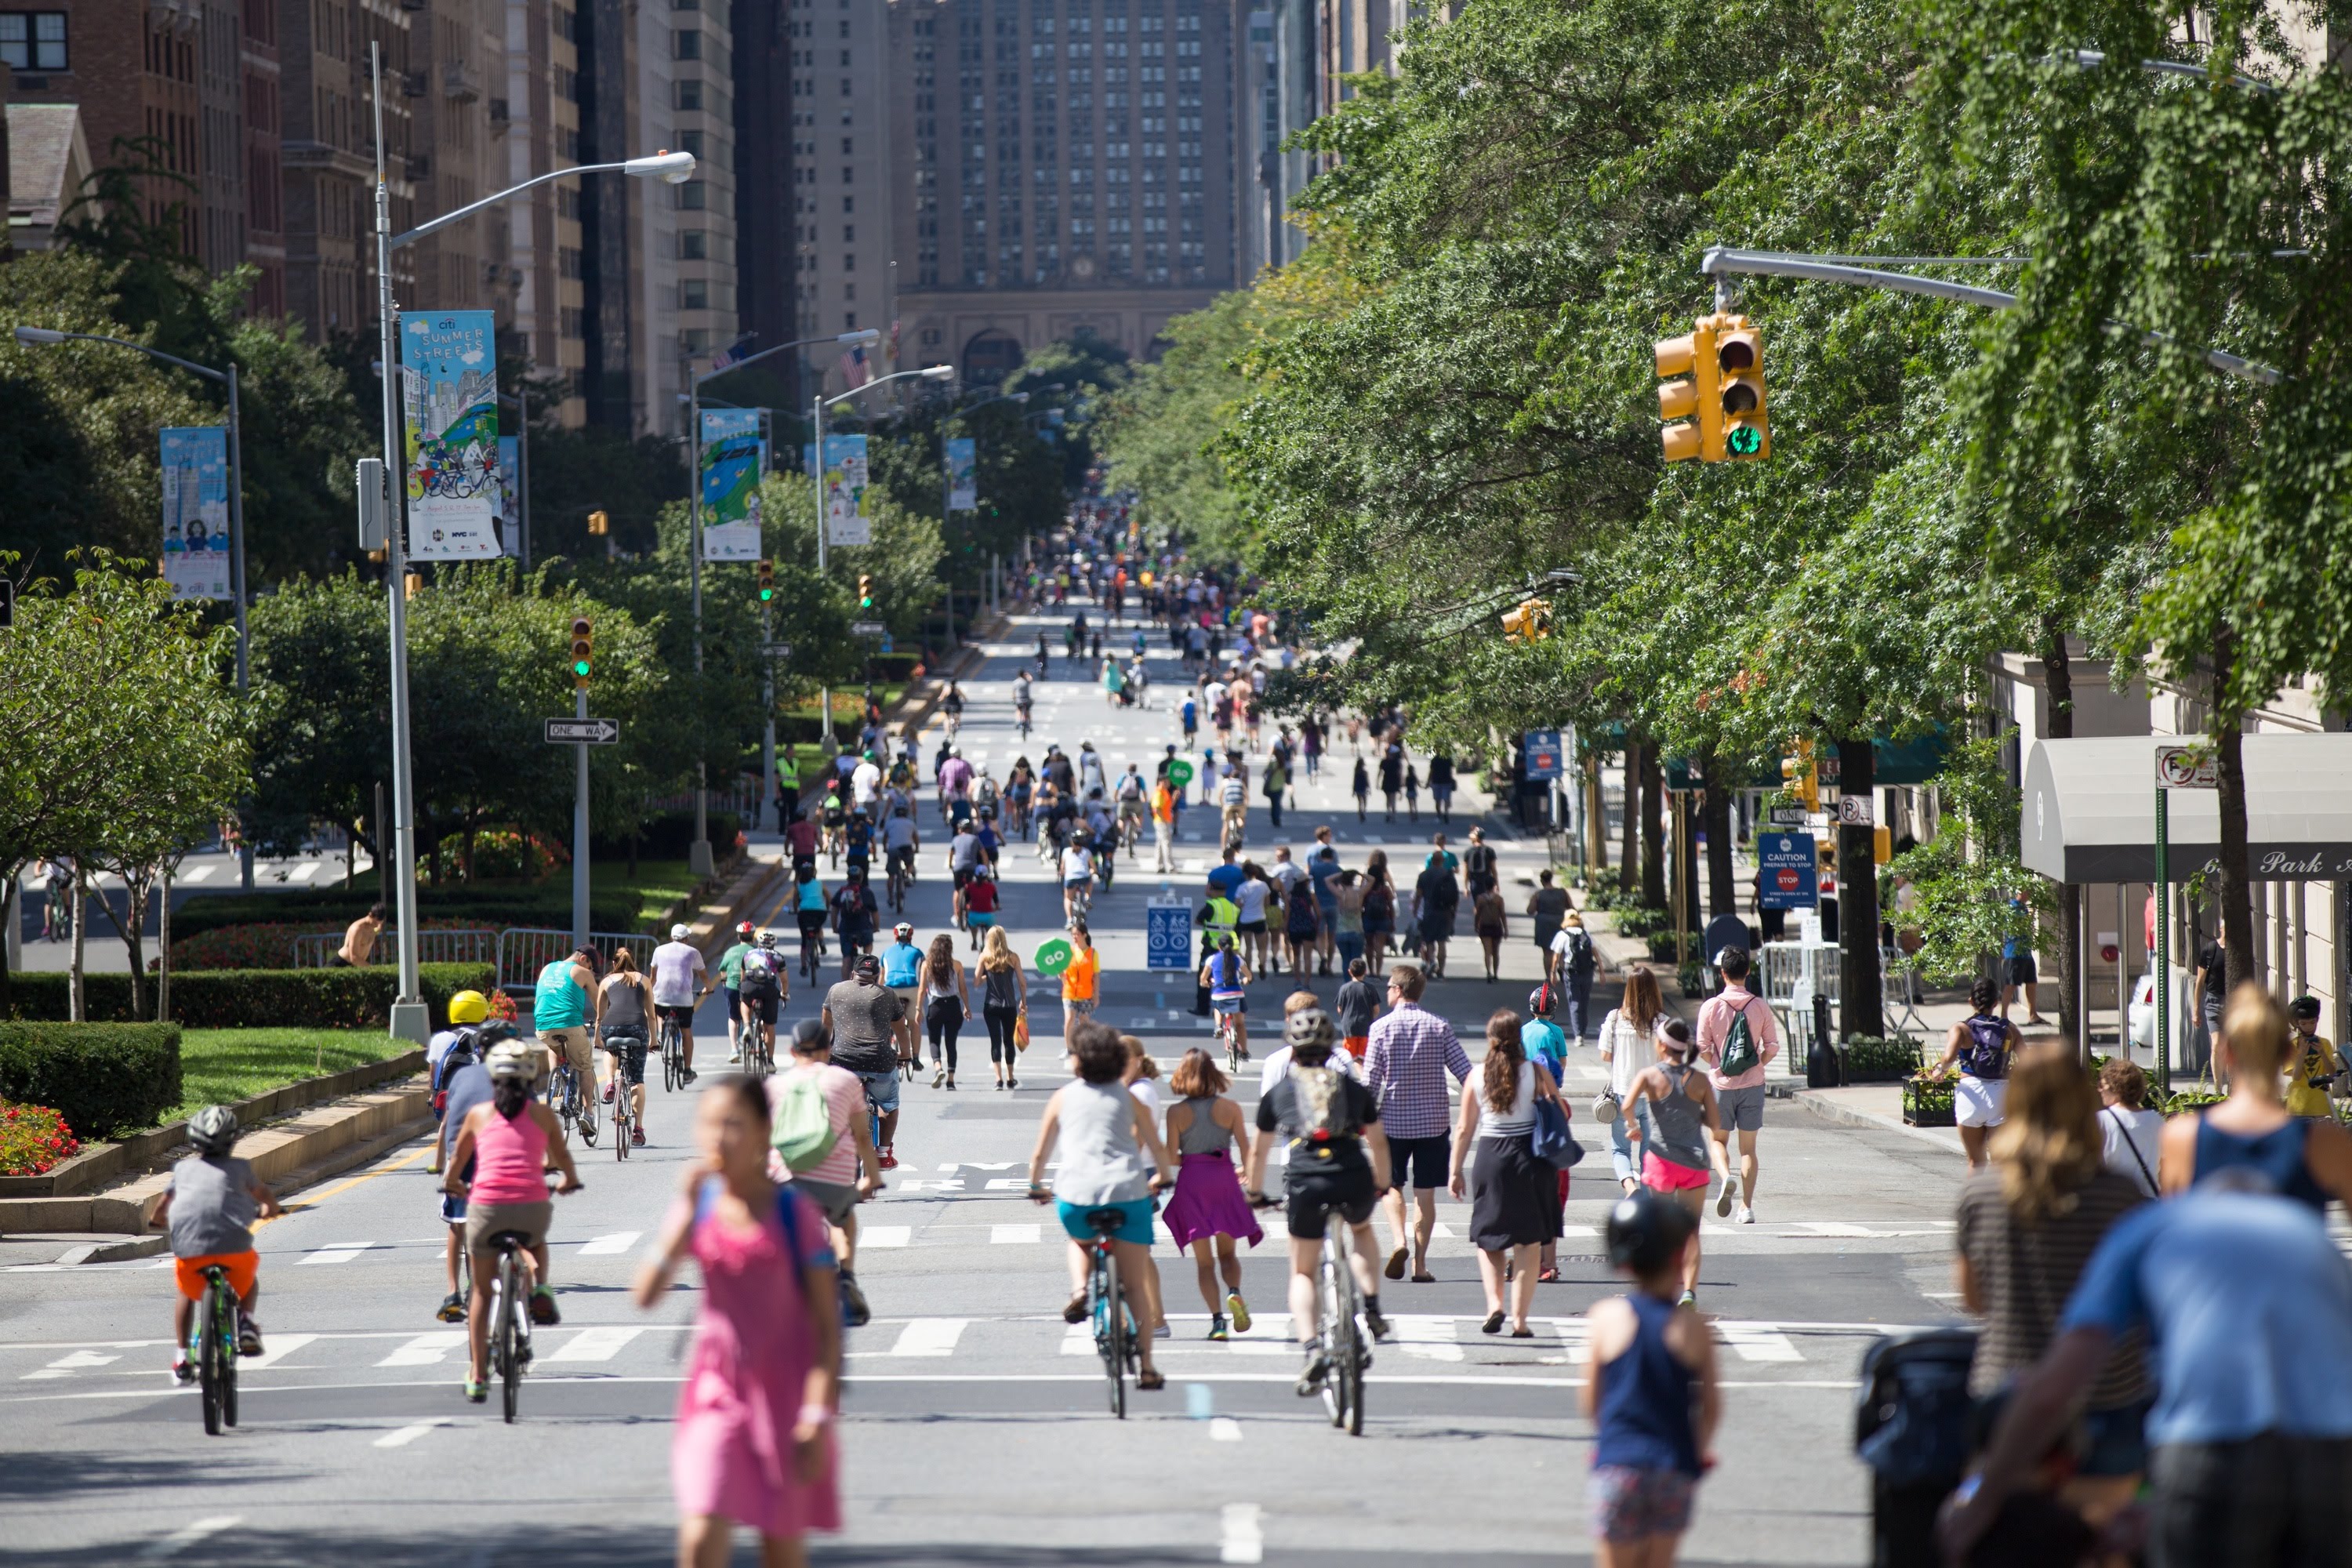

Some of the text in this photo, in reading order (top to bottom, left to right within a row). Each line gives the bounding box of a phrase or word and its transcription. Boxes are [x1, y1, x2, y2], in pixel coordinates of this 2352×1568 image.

[439, 318, 456, 329] citi
[423, 329, 484, 346] SUMMER
[414, 340, 484, 362] STREETS
[553, 725, 608, 735] ONE WAY
[1780, 810, 1802, 820] ONE
[2259, 851, 2324, 873] Park
[1044, 950, 1065, 966] GO
